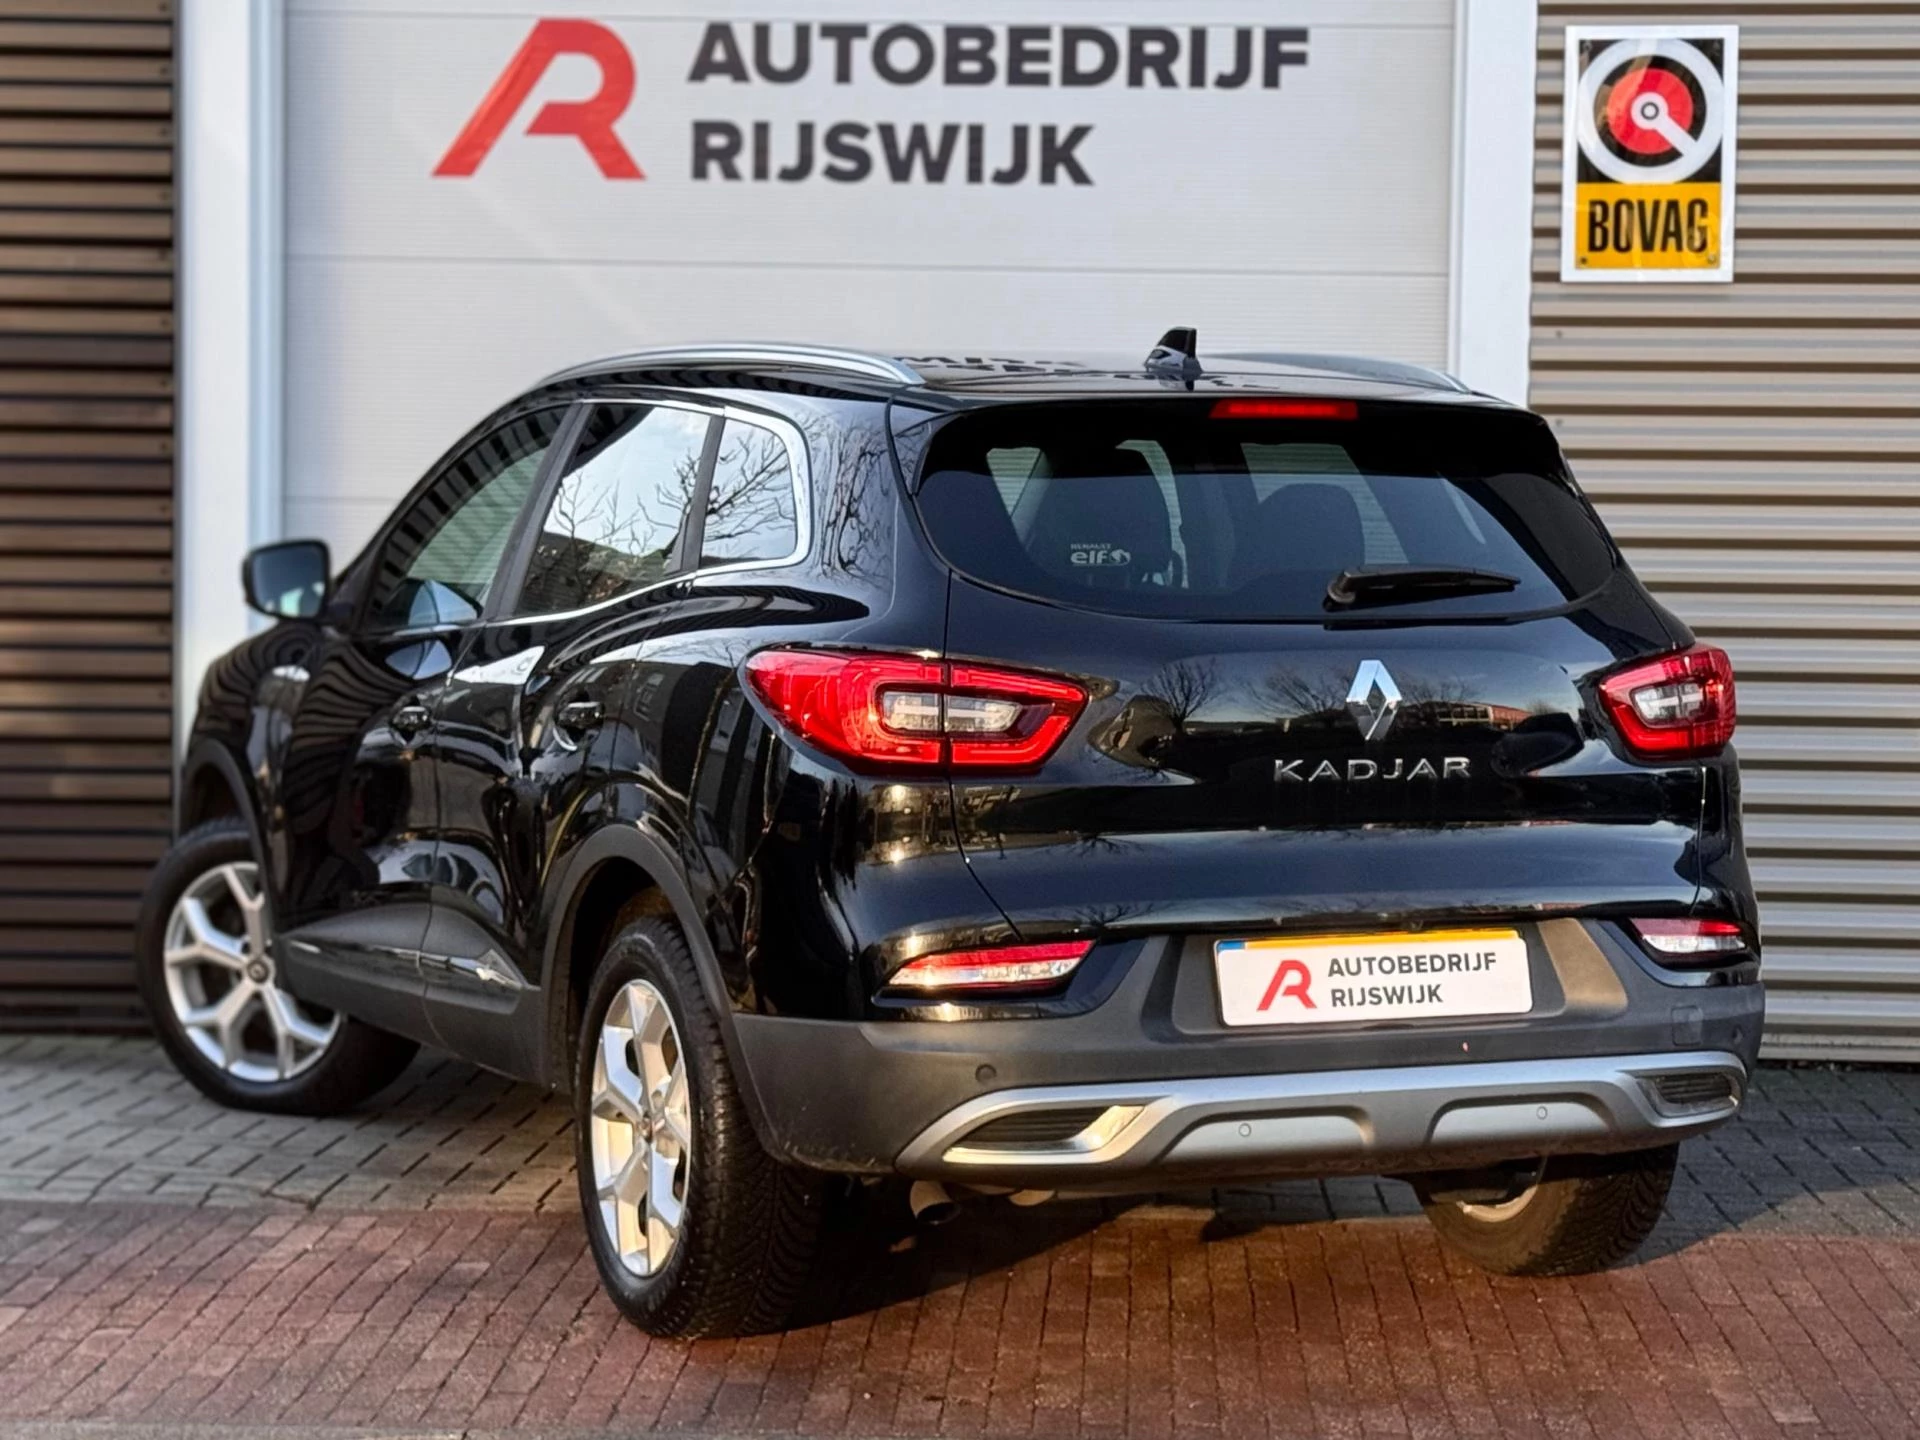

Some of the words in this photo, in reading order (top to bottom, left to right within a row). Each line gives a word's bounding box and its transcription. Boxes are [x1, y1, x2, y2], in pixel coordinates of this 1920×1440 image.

[687, 22, 1310, 89] AUTOBEDRIJF
[691, 121, 1094, 186] RIJSWIJK
[1588, 198, 1709, 253] BOVAG
[1070, 550, 1108, 564] elf
[1274, 757, 1471, 783] KADJAR
[1327, 952, 1498, 978] AUTOBEDRIJF
[1331, 984, 1443, 1008] RIJSWIJK
